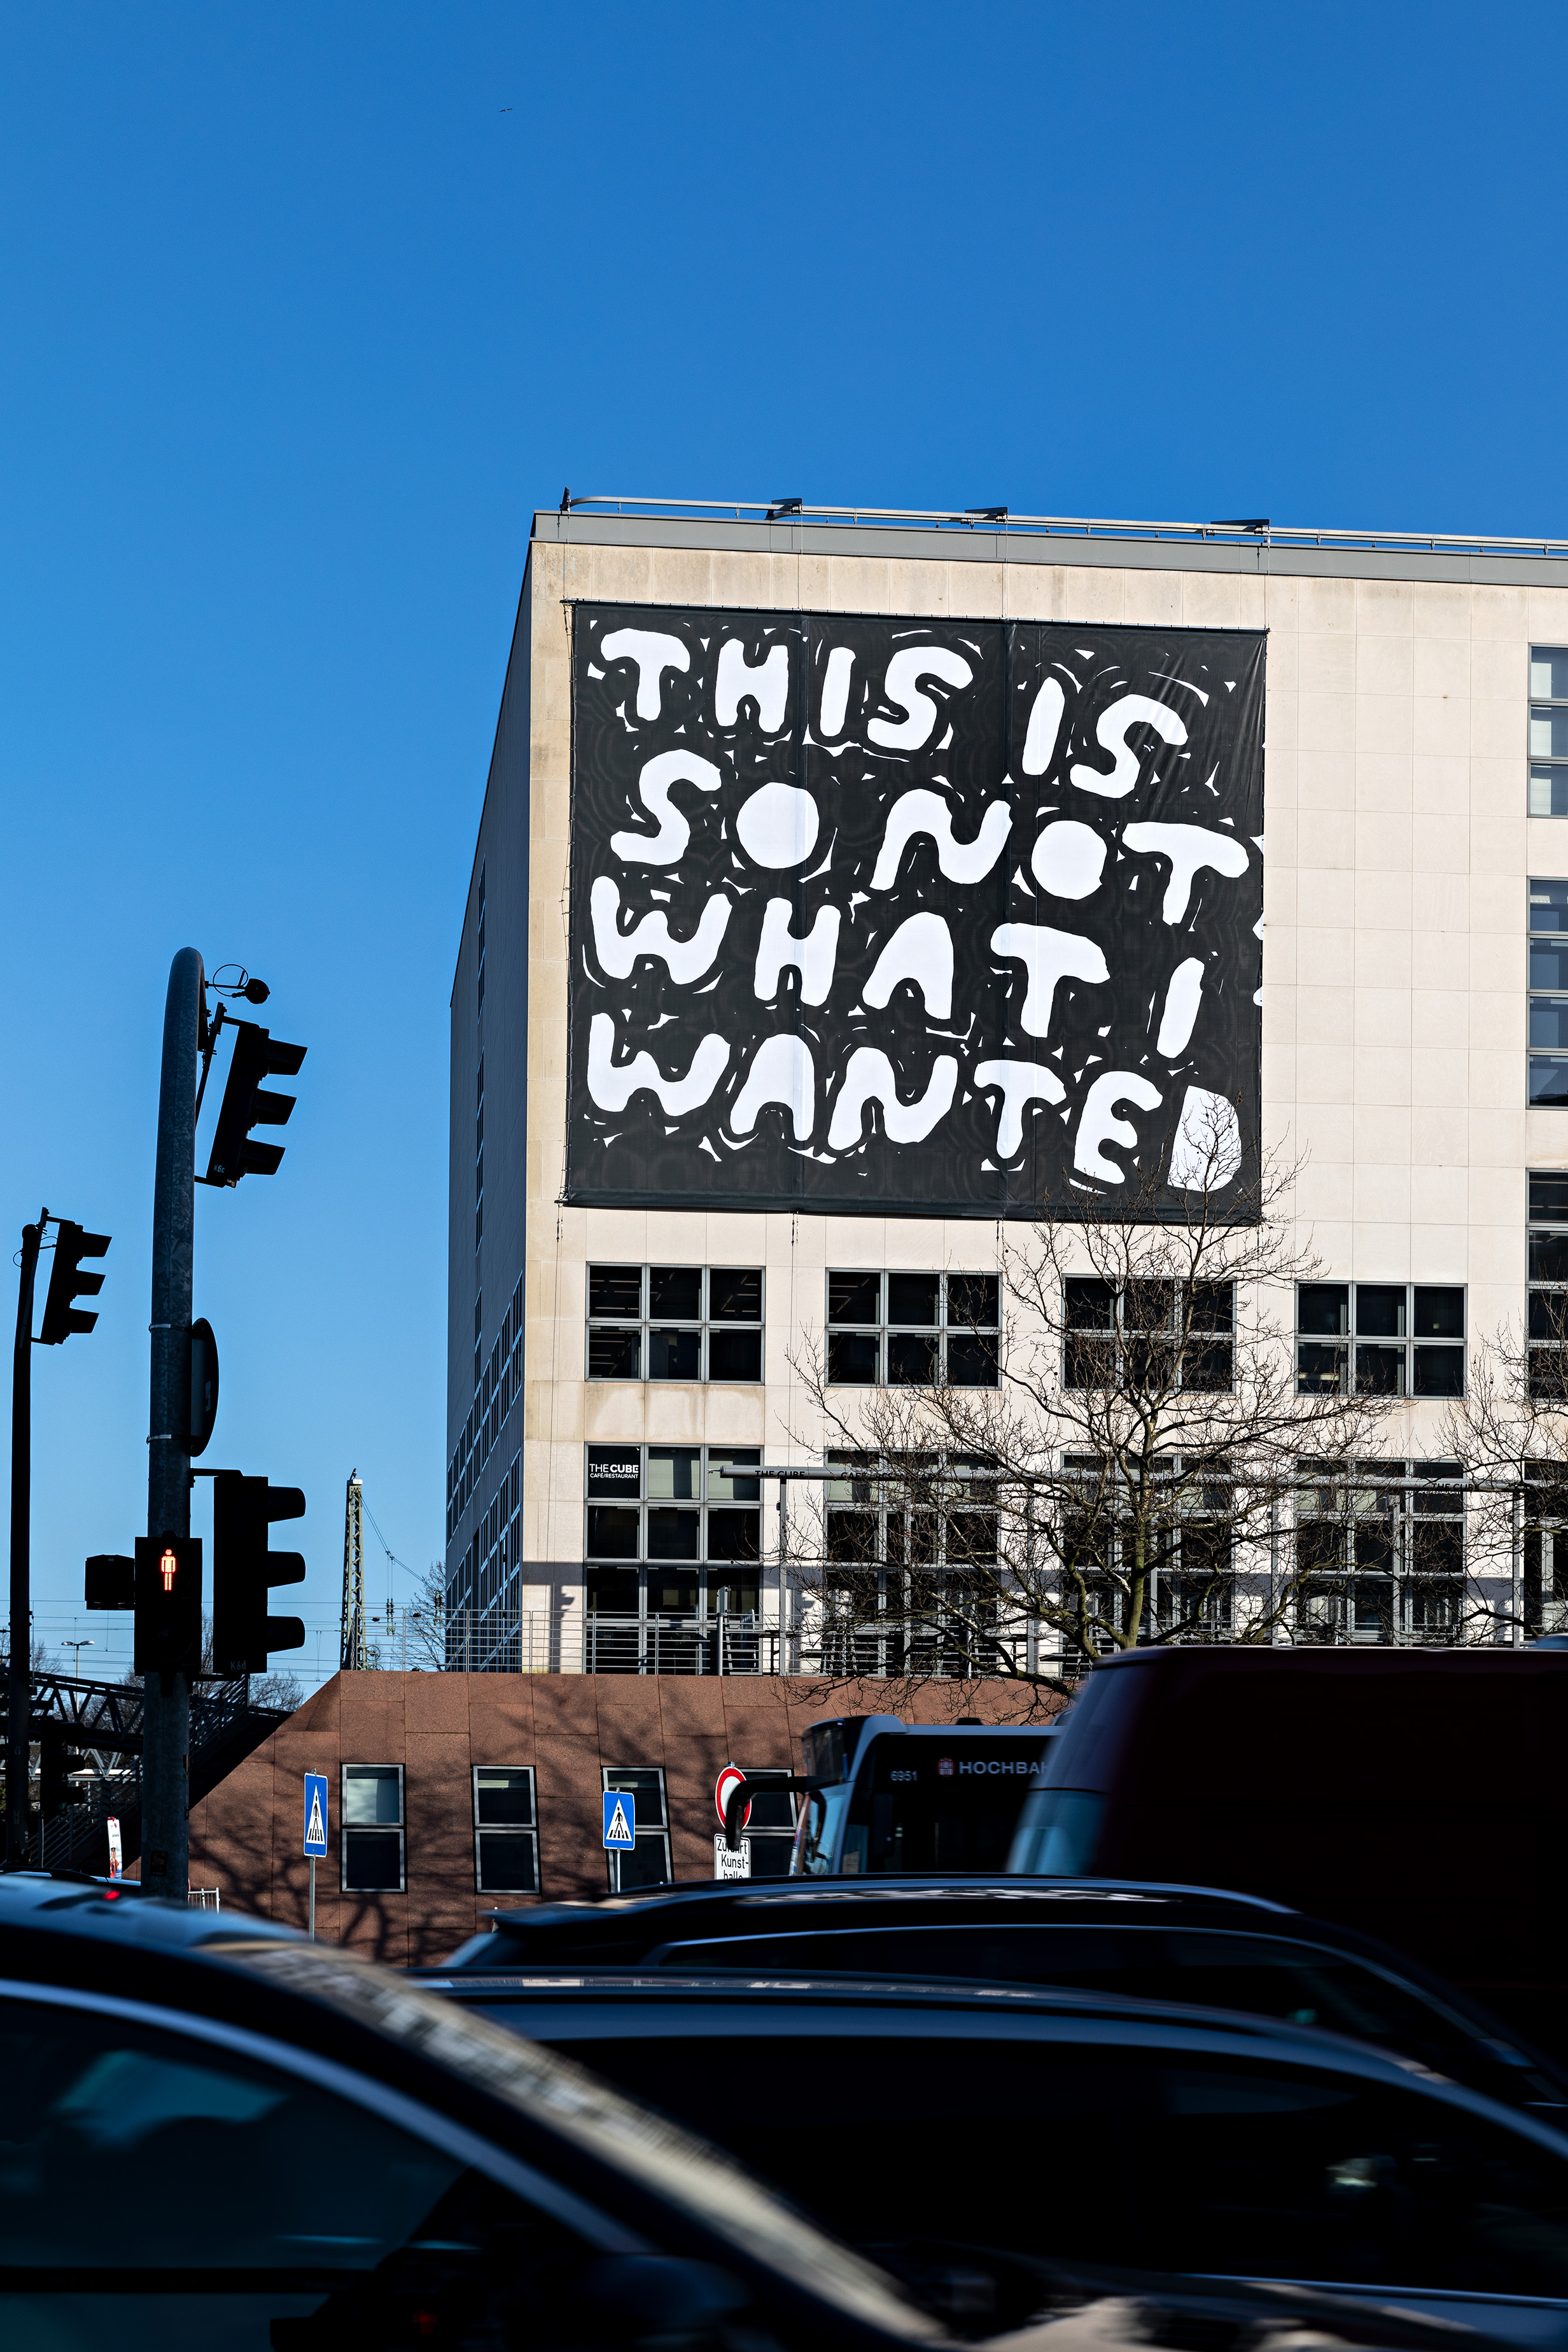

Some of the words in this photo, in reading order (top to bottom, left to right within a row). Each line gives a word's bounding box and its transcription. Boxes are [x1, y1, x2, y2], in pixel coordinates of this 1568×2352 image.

[601, 627, 974, 751] THIS
[1021, 676, 1189, 799] IS
[610, 748, 820, 869] SO
[869, 788, 1250, 926] NOT
[590, 876, 1111, 1039] WHAT
[1156, 957, 1205, 1059] I
[587, 1012, 1242, 1193] WANTED
[213, 1165, 225, 1173] K6c
[589, 1464, 609, 1473] THE
[610, 1464, 639, 1473] CUBE
[230, 1660, 247, 1670] K6d
[890, 1770, 918, 1781] 6951
[717, 1838, 747, 1855] Zurt
[721, 1854, 749, 1870] Kunst-
